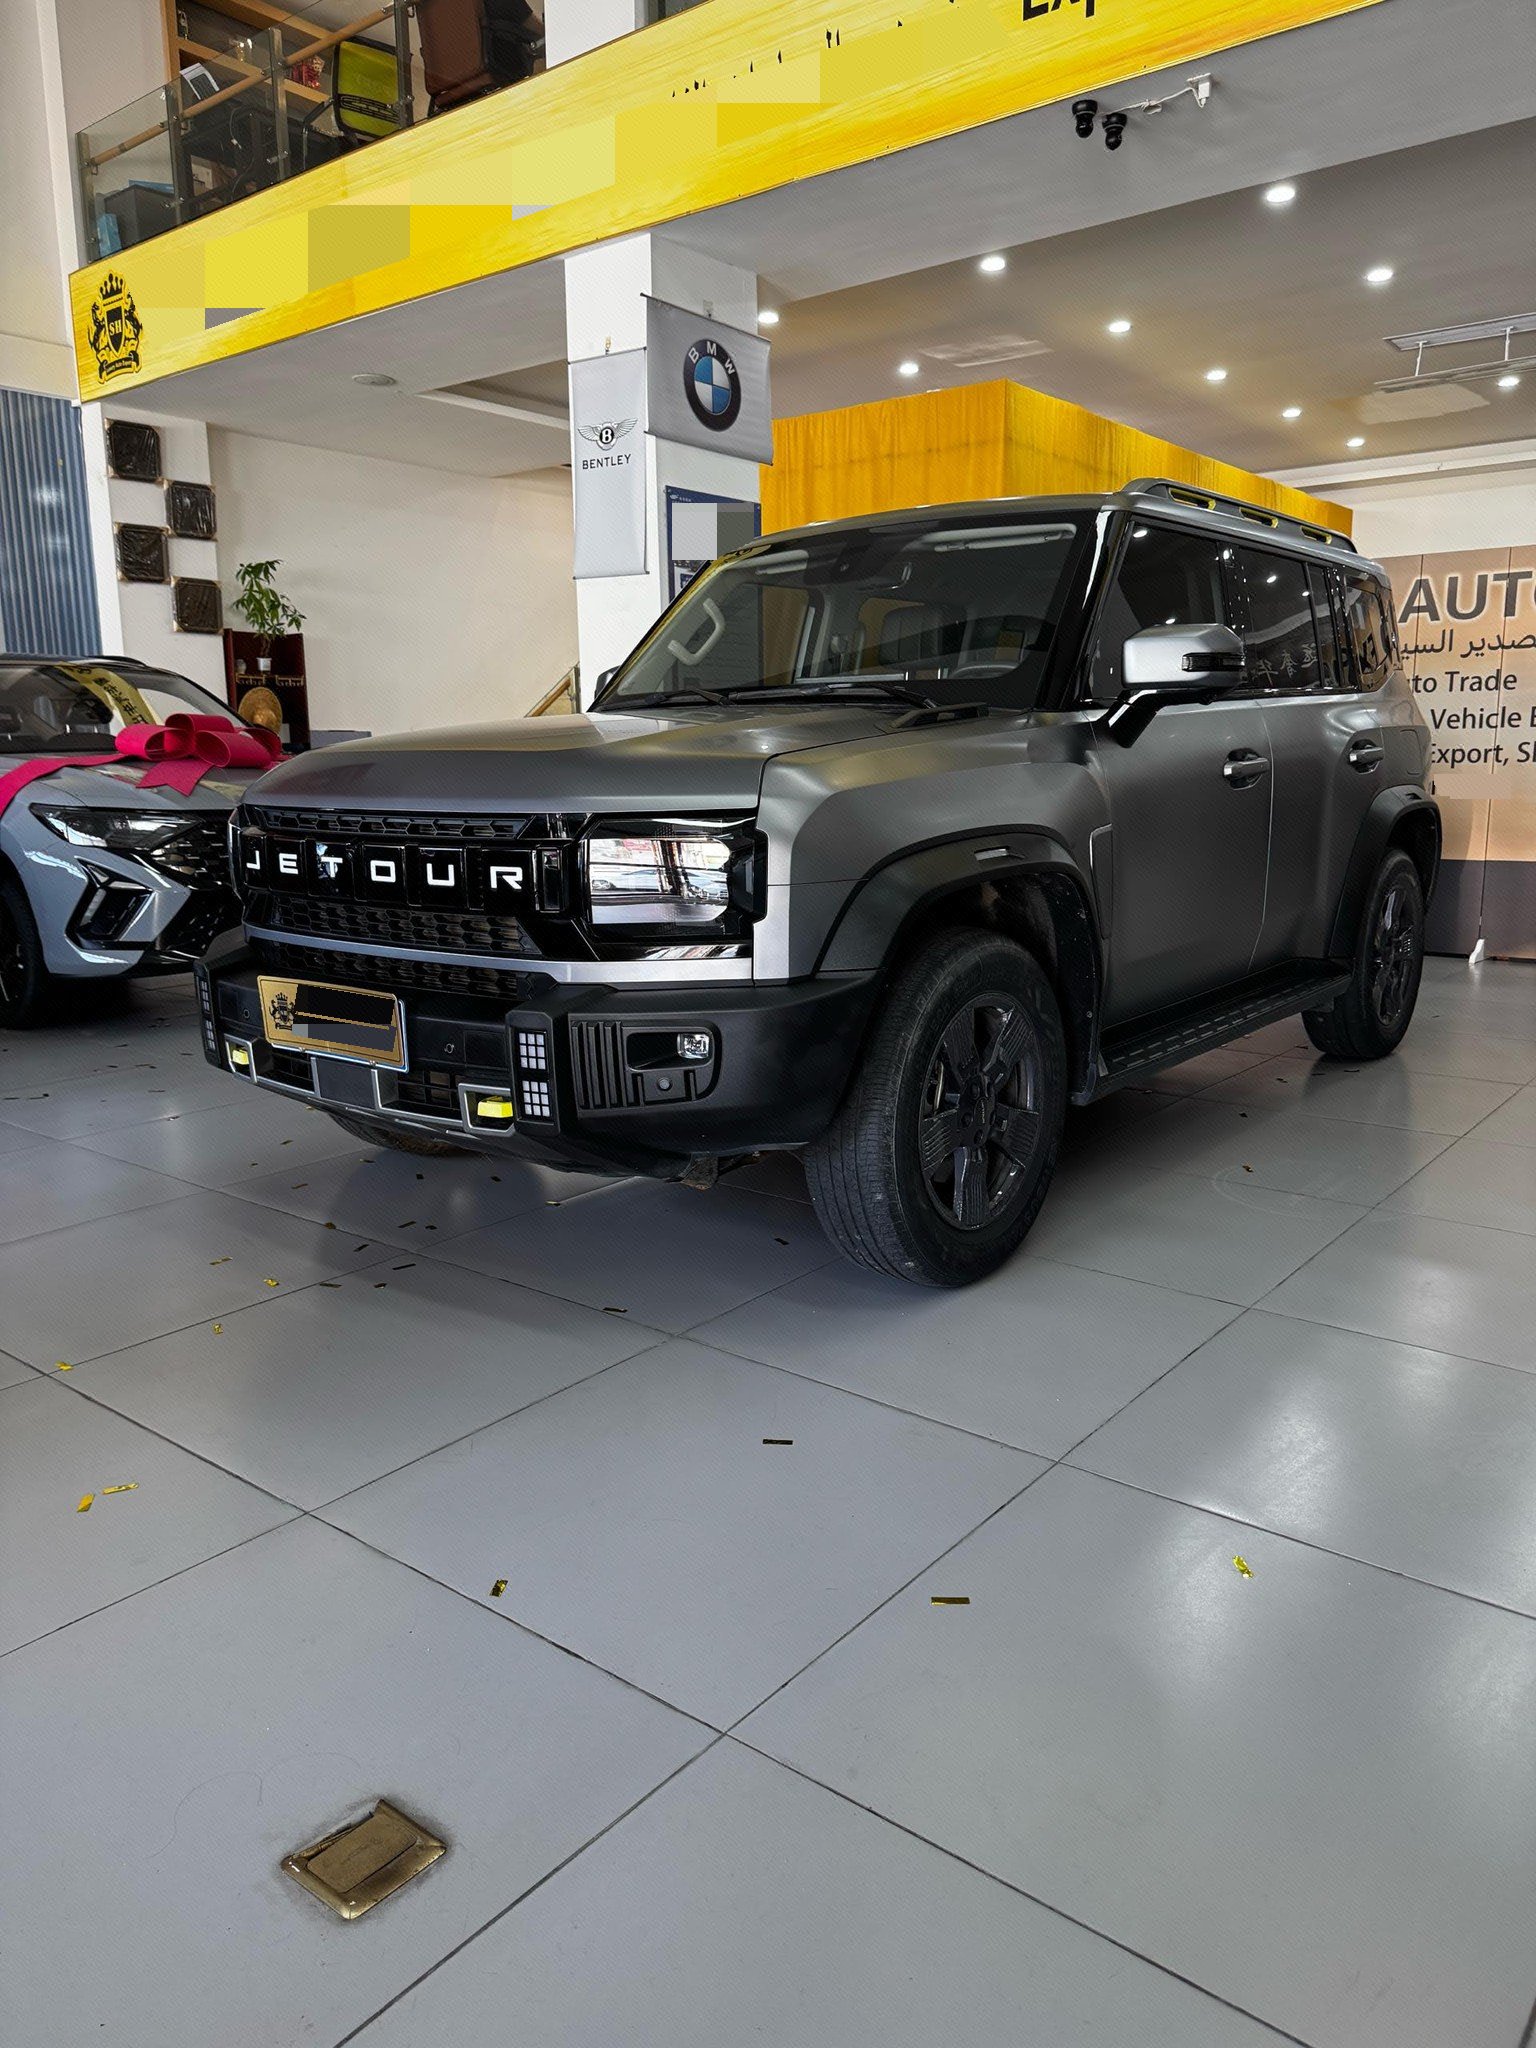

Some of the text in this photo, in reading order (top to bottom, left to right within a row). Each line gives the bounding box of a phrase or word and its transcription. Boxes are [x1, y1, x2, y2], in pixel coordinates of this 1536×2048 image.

[109, 319, 122, 336] SH
[688, 341, 735, 375] BMW
[582, 453, 632, 470] BENTLEY
[1398, 571, 1536, 623] AUT
[1401, 628, 1454, 659] السي
[1460, 634, 1536, 658] صدير
[1444, 668, 1518, 692] Trade
[1430, 706, 1522, 730] Vehicle
[1517, 741, 1536, 763] S
[246, 850, 523, 889] JETOUR
